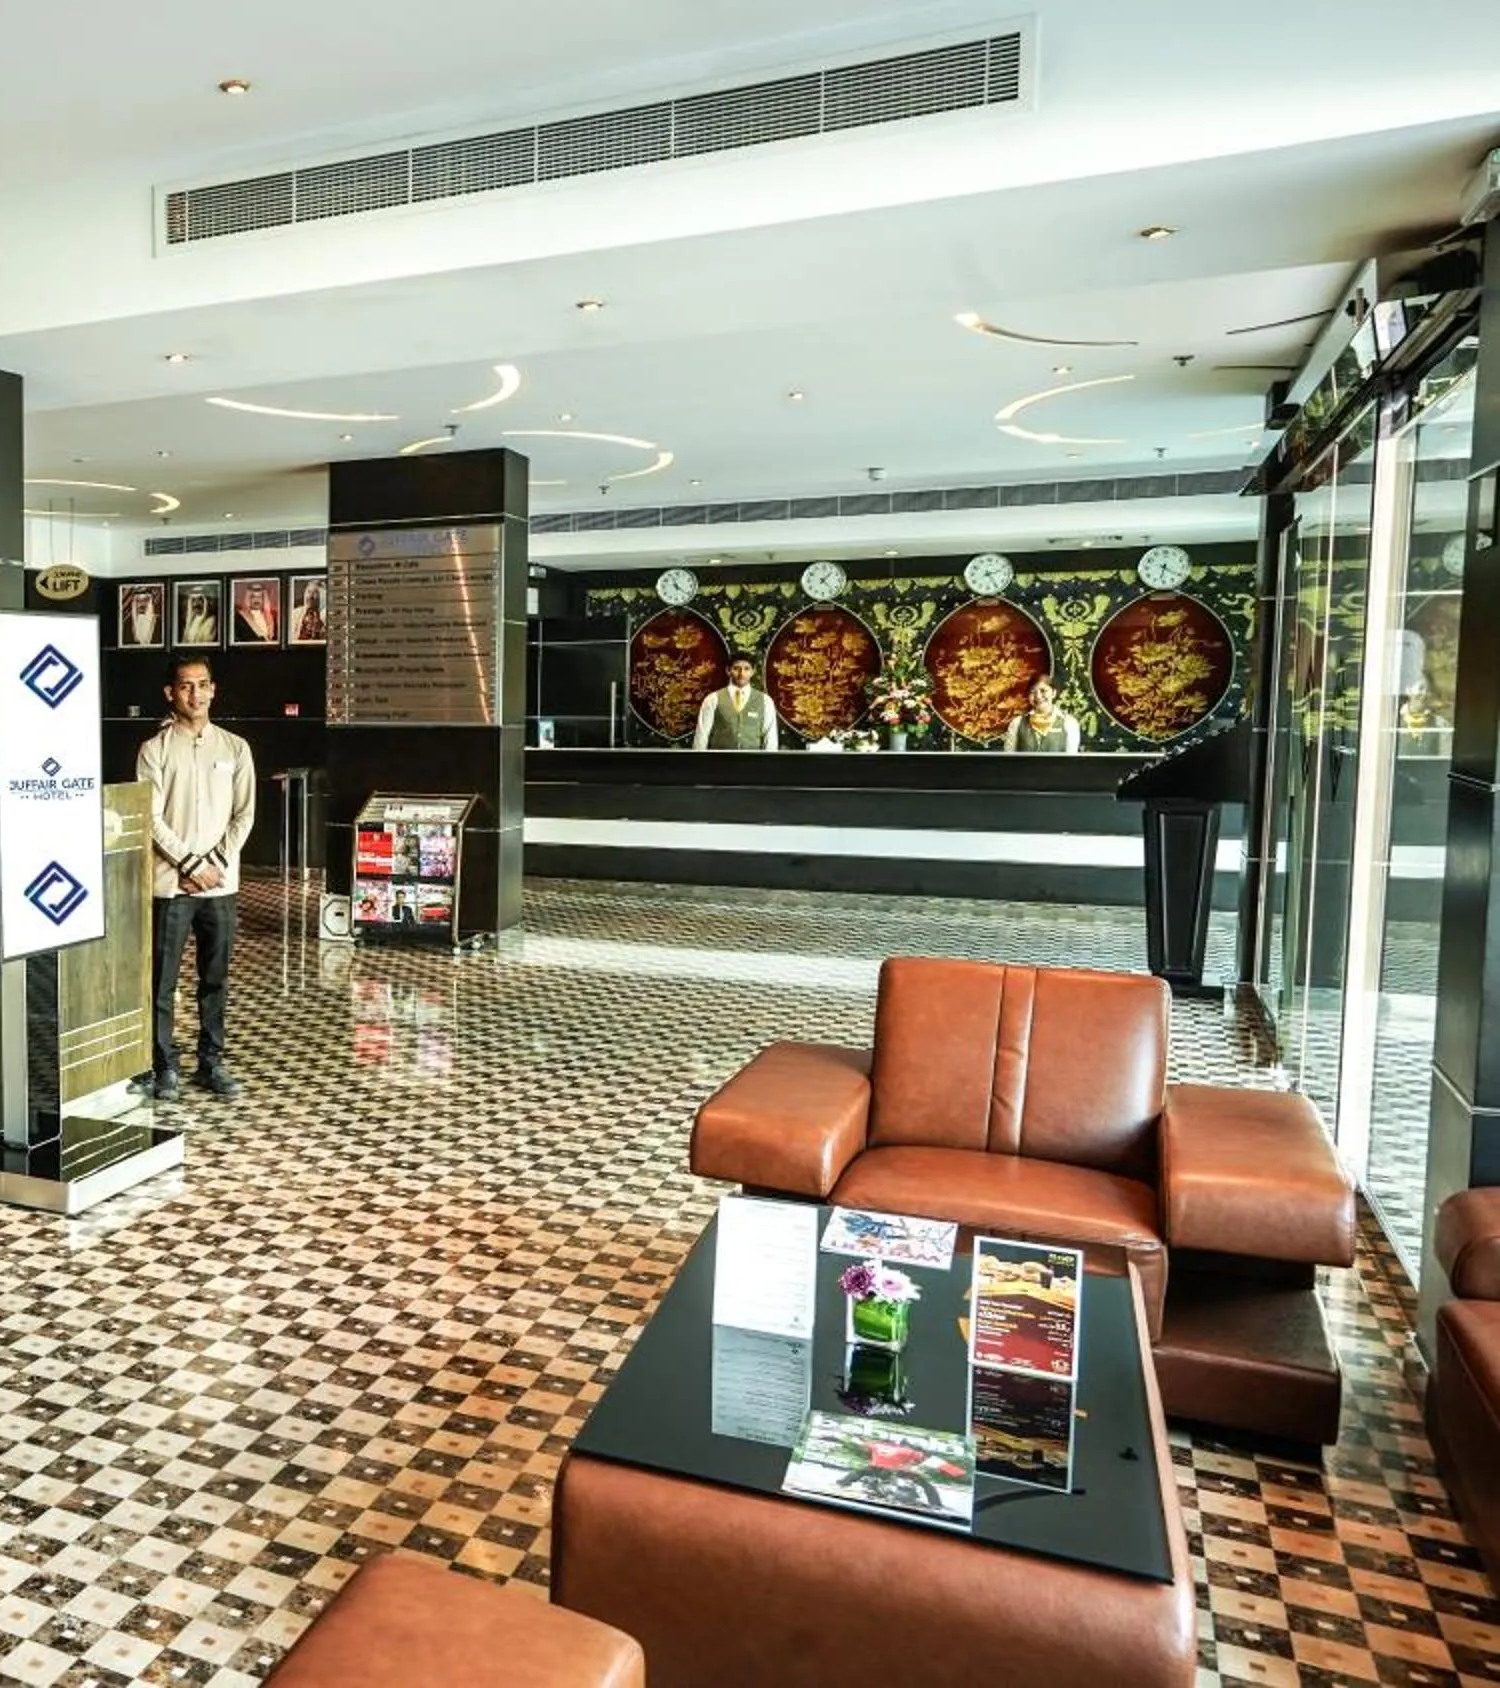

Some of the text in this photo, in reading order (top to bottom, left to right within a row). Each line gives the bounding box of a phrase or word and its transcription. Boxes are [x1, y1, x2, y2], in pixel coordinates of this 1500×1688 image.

[54, 579, 80, 592] LIFT
[9, 777, 94, 791] JUFFAIR GATE
[33, 790, 72, 801] HOTEL
